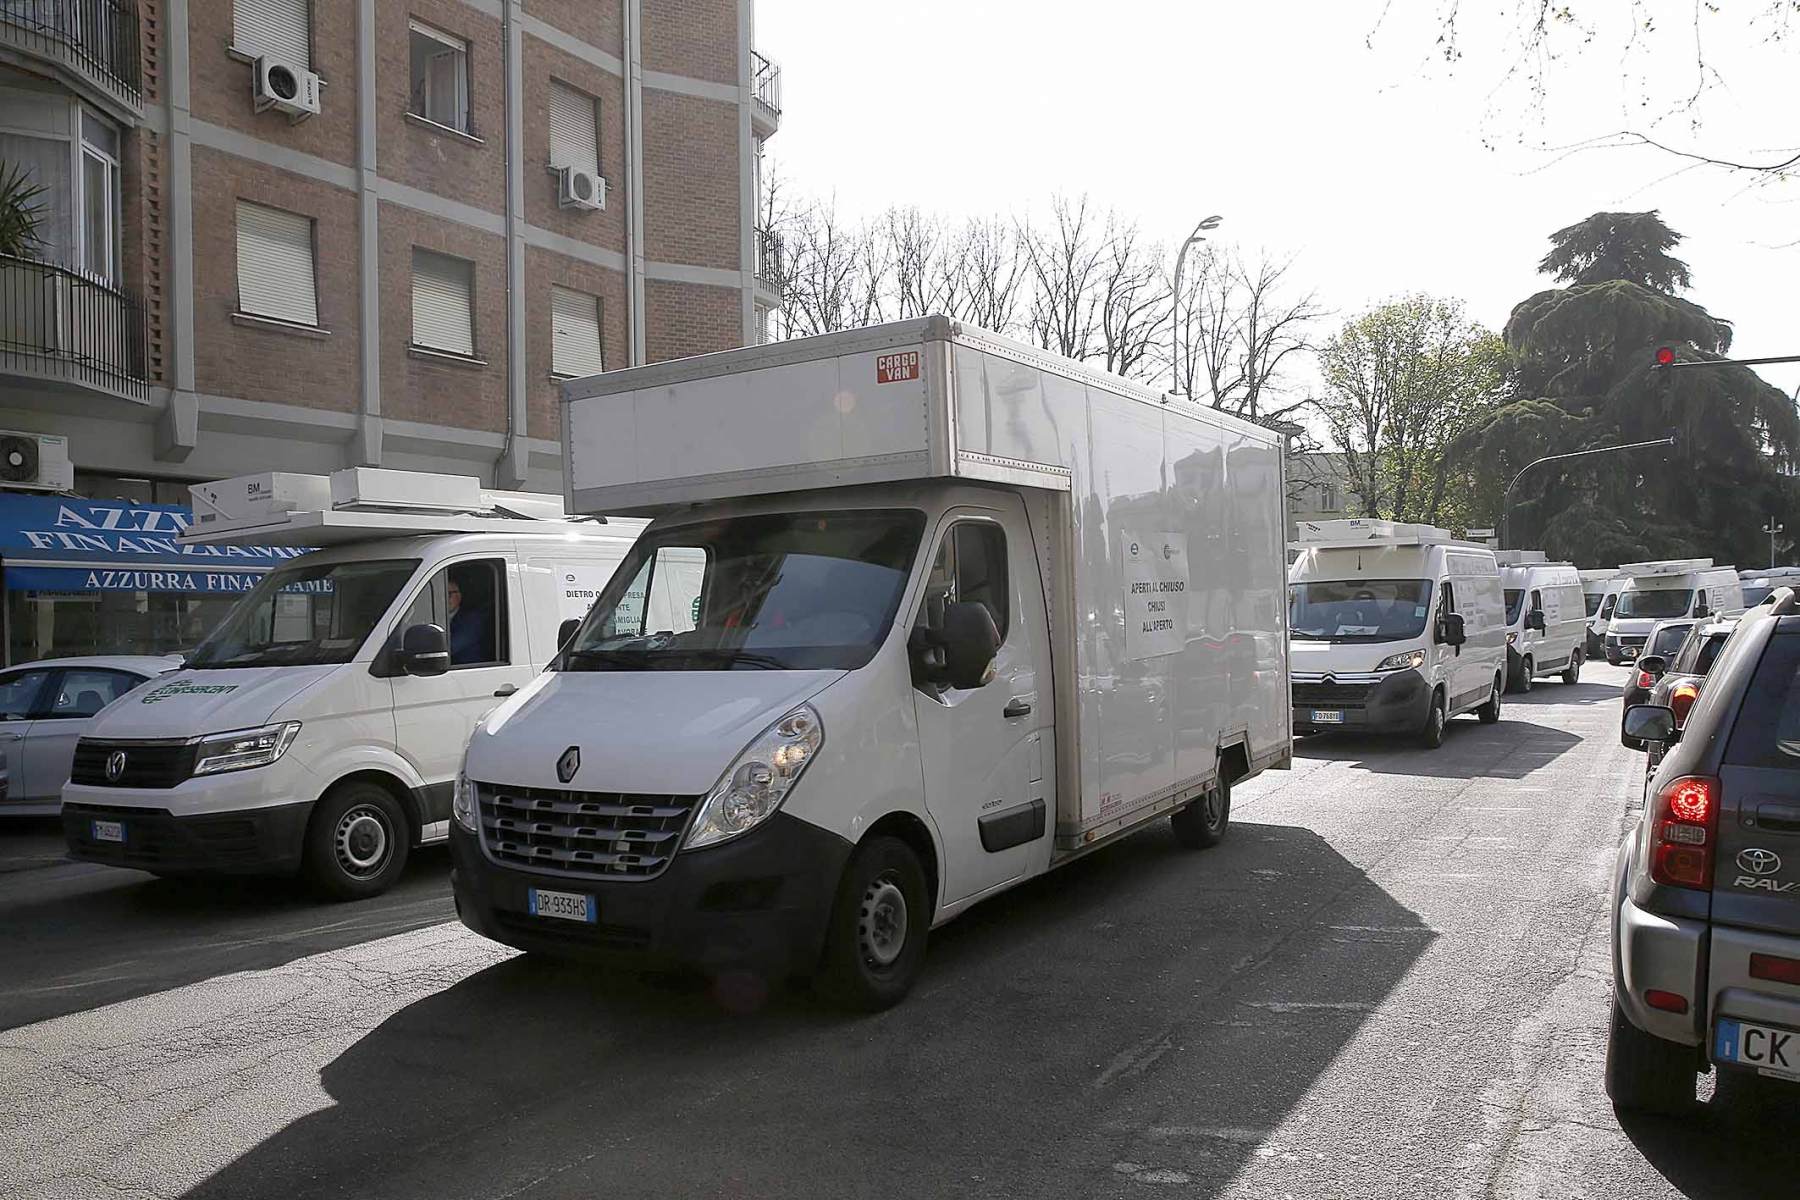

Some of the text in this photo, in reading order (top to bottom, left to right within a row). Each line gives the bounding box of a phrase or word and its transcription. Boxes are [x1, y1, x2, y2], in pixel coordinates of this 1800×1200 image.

[879, 353, 917, 370] CARGO
[886, 366, 910, 380] VAN
[248, 483, 260, 494] BM
[85, 571, 196, 589] AZZURRA
[566, 590, 594, 598] DIETRO
[1131, 582, 1151, 594] APERTI
[1159, 581, 1184, 593] CHIUSO
[1147, 600, 1165, 612] CHIUSI
[1142, 618, 1173, 633] ALL'APERTO
[1744, 1028, 1791, 1067] CK
